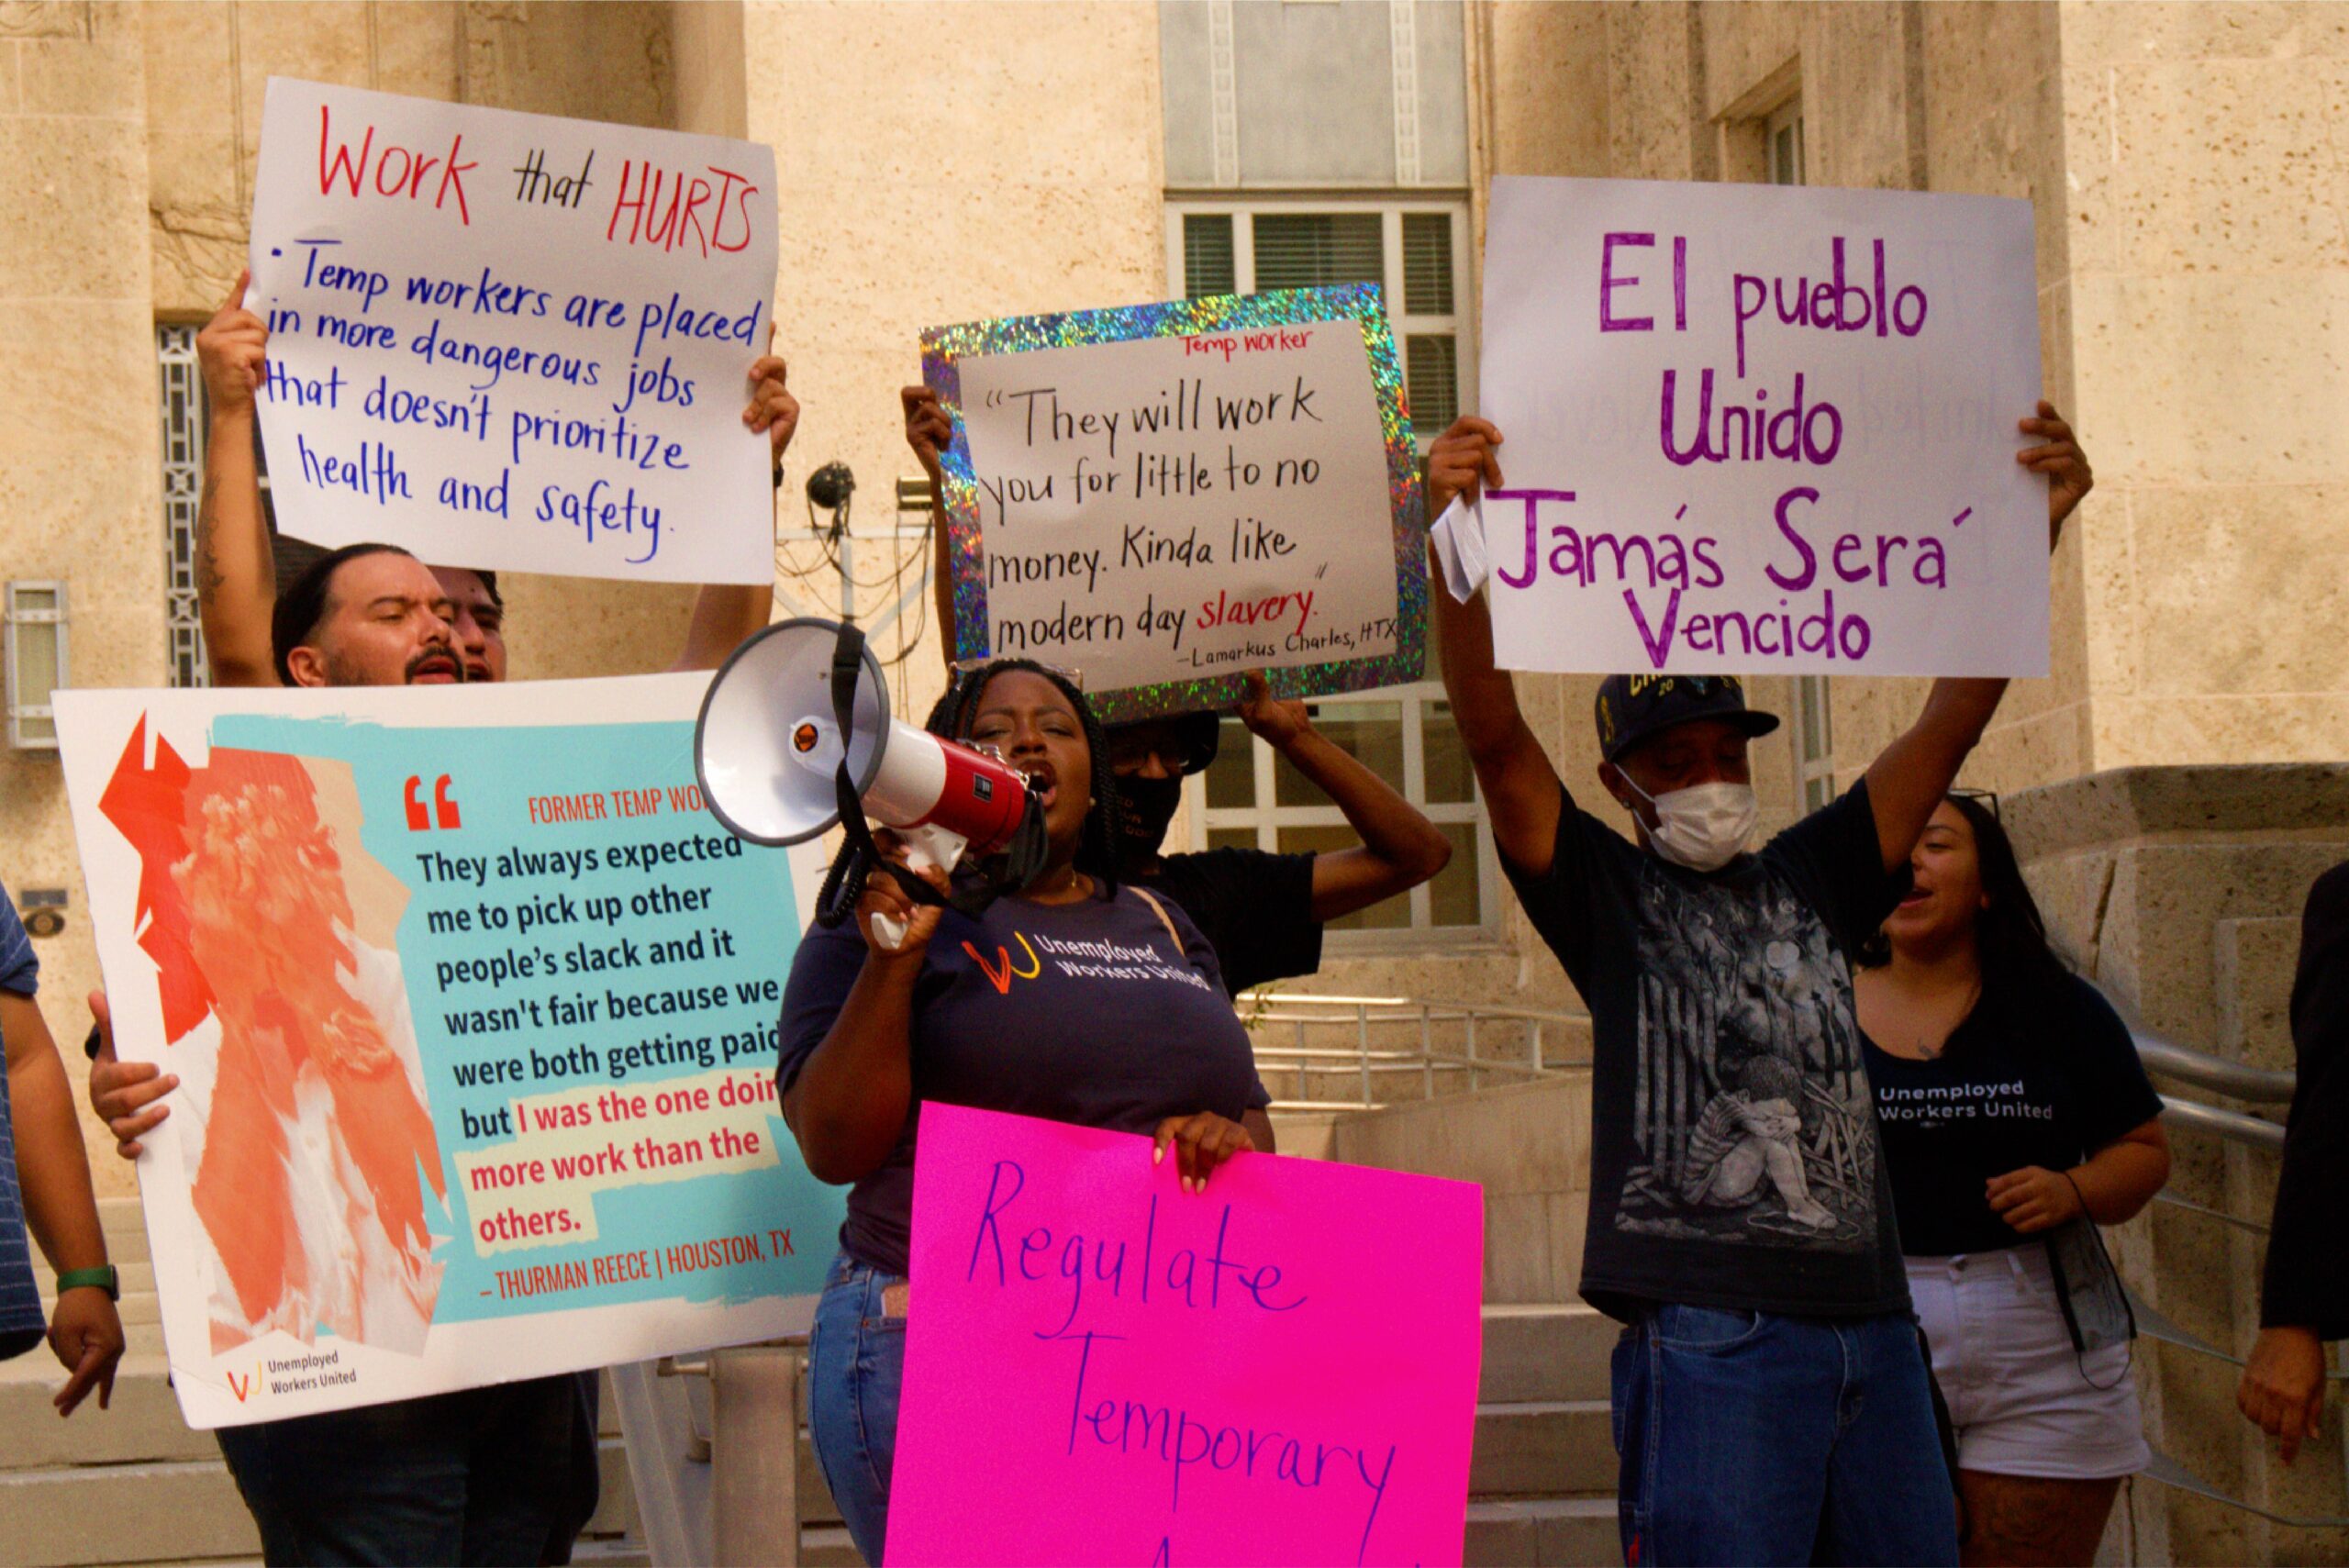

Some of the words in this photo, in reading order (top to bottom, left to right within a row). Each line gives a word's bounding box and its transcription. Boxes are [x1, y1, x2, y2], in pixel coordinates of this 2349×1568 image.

[319, 105, 479, 226] Work
[513, 149, 595, 208] that
[607, 160, 758, 259] HURTS
[294, 239, 389, 313] Temp
[406, 267, 552, 317] workers
[563, 294, 626, 328] are
[633, 293, 763, 356] placed
[1599, 231, 1687, 332] El
[1733, 237, 1928, 379] pueblo
[267, 297, 300, 334] in
[317, 317, 397, 350] more
[411, 319, 601, 390] dangerous
[613, 356, 695, 413] jobs
[1178, 335, 1238, 362] Temp
[1244, 329, 1314, 352] worker
[264, 358, 348, 409] that
[363, 375, 492, 440] doesn't
[512, 409, 690, 470] prioritize
[1132, 378, 1202, 433] will
[1216, 375, 1323, 430] work
[1659, 367, 1842, 465] Unido
[297, 433, 412, 505] health
[439, 468, 509, 518] and
[536, 479, 675, 563] safety.
[979, 473, 1053, 526] you
[1070, 456, 1121, 504] for
[1135, 452, 1212, 498] little
[1223, 444, 1261, 491] to
[1275, 457, 1320, 488] no
[988, 549, 1108, 593] money.
[1121, 524, 1214, 567] Kinda
[1231, 518, 1297, 563] like
[1484, 489, 1725, 591] Jamás
[997, 600, 1124, 653] modern
[1137, 594, 1186, 650] day
[1360, 618, 1397, 643] HTX
[1622, 587, 1871, 669] Vencido
[528, 793, 607, 824] FORMER
[611, 789, 662, 818] TEMP
[667, 784, 710, 814] WO
[416, 851, 487, 887] They
[496, 846, 599, 880] always
[607, 832, 742, 872] expected
[427, 907, 473, 934] me
[478, 903, 509, 929] to
[516, 893, 577, 934] pick
[584, 897, 623, 926] up
[630, 883, 712, 916] other
[564, 938, 642, 973] slack
[649, 929, 705, 965] and
[711, 928, 736, 958] it
[1033, 934, 1162, 963] Unemployed
[1055, 961, 1148, 980] Workers
[1146, 964, 1212, 992] United
[444, 999, 543, 1036] wasn't
[549, 994, 599, 1027] fair
[607, 984, 729, 1020] because
[736, 979, 780, 1005] we
[452, 1058, 524, 1087] were
[529, 1043, 600, 1080] both
[608, 1030, 716, 1078] getting
[461, 1106, 512, 1139] but
[517, 1104, 528, 1133] I
[534, 1101, 593, 1132] was
[597, 1090, 648, 1124] the
[654, 1085, 711, 1117] one
[1878, 1105, 1976, 1121] Workers
[1985, 1101, 2053, 1119] United
[1880, 1080, 2024, 1101] Unemployed
[470, 1161, 545, 1191] more
[551, 1143, 627, 1180] work
[633, 1133, 704, 1170] than
[708, 1127, 761, 1159] the
[479, 1208, 582, 1243] others.
[968, 1161, 1308, 1340] Regulate
[495, 1260, 589, 1300] THURMAN
[593, 1251, 651, 1285] REECE
[667, 1235, 766, 1274] HOUSTON,
[768, 1228, 795, 1257] TX
[268, 1350, 339, 1373] Unemployed
[271, 1375, 317, 1395] Workers
[320, 1369, 357, 1387] United
[1058, 1331, 1397, 1568] Temporary
